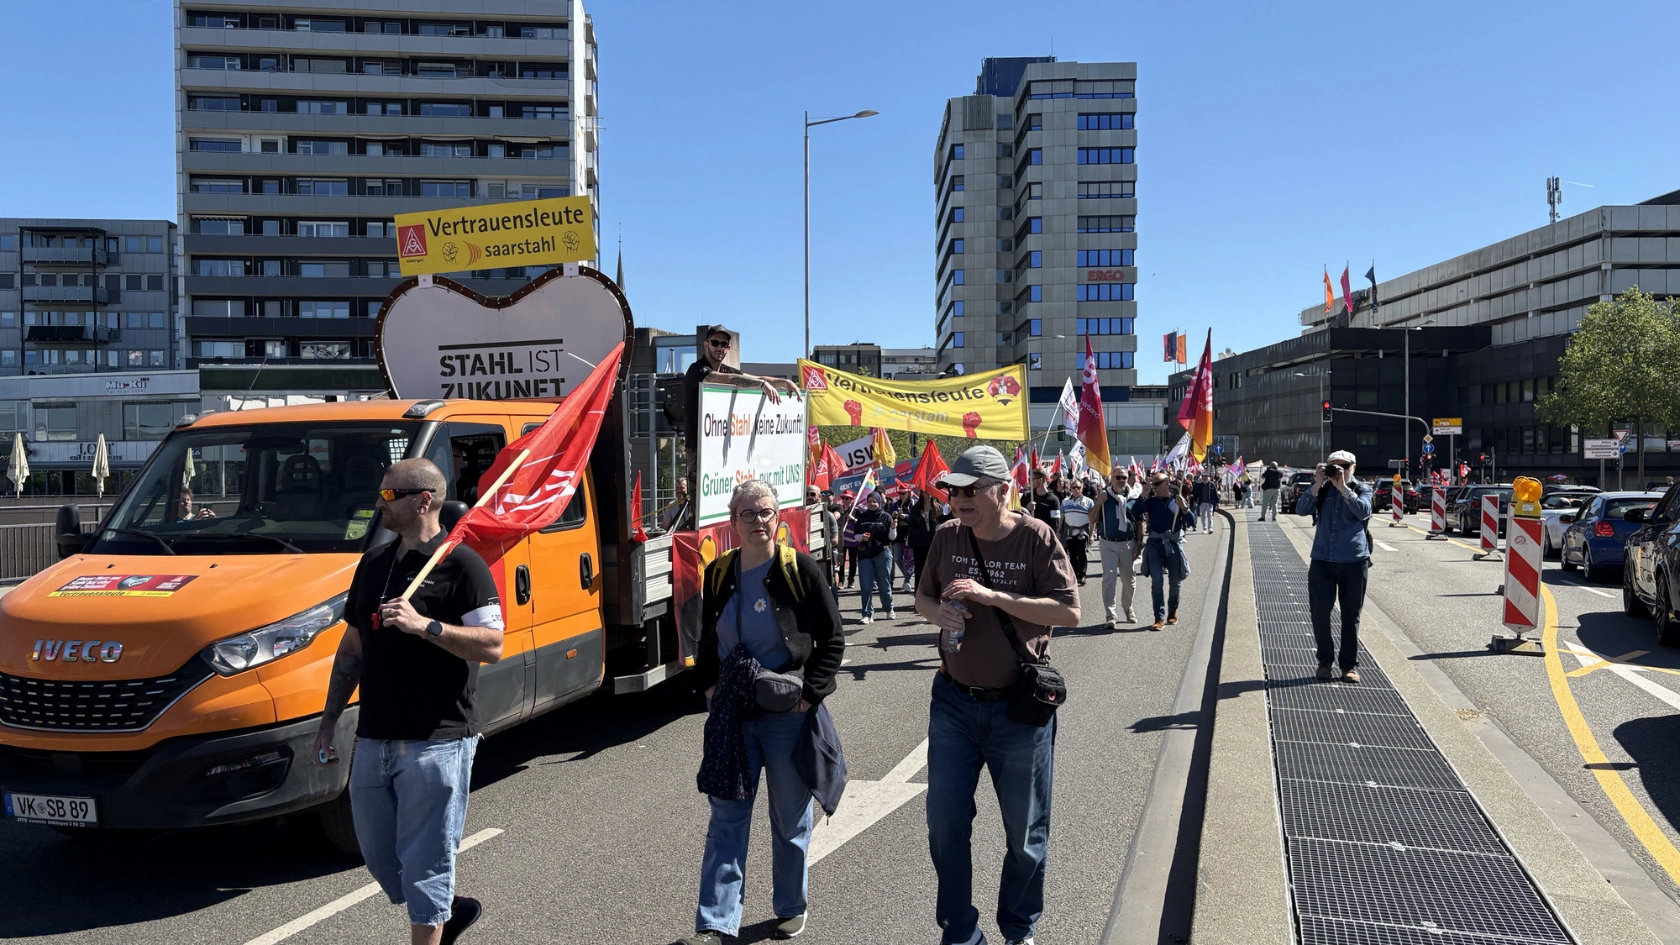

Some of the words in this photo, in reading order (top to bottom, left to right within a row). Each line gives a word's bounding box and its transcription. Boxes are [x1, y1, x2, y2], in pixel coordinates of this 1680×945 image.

[427, 206, 584, 237] Vertrauensleute
[485, 235, 556, 258] saarstahl
[1088, 269, 1123, 281] ERGO
[440, 352, 523, 377] STAHL
[529, 349, 564, 373] IST
[441, 378, 565, 400] ZUKUNFT
[704, 413, 728, 437] Ohne
[755, 413, 774, 436] keine
[775, 413, 803, 435] Zukunft!
[79, 442, 114, 455] LOT
[702, 471, 733, 497] Grüner
[773, 467, 784, 486] mit
[785, 463, 802, 485] UNS!
[951, 555, 968, 564] TOM
[971, 558, 1001, 569] TALOR
[1005, 562, 1027, 570] TEAM
[32, 639, 123, 663] IVECO
[17, 797, 37, 816] VK
[46, 799, 66, 818] SB
[69, 800, 89, 819] 89
